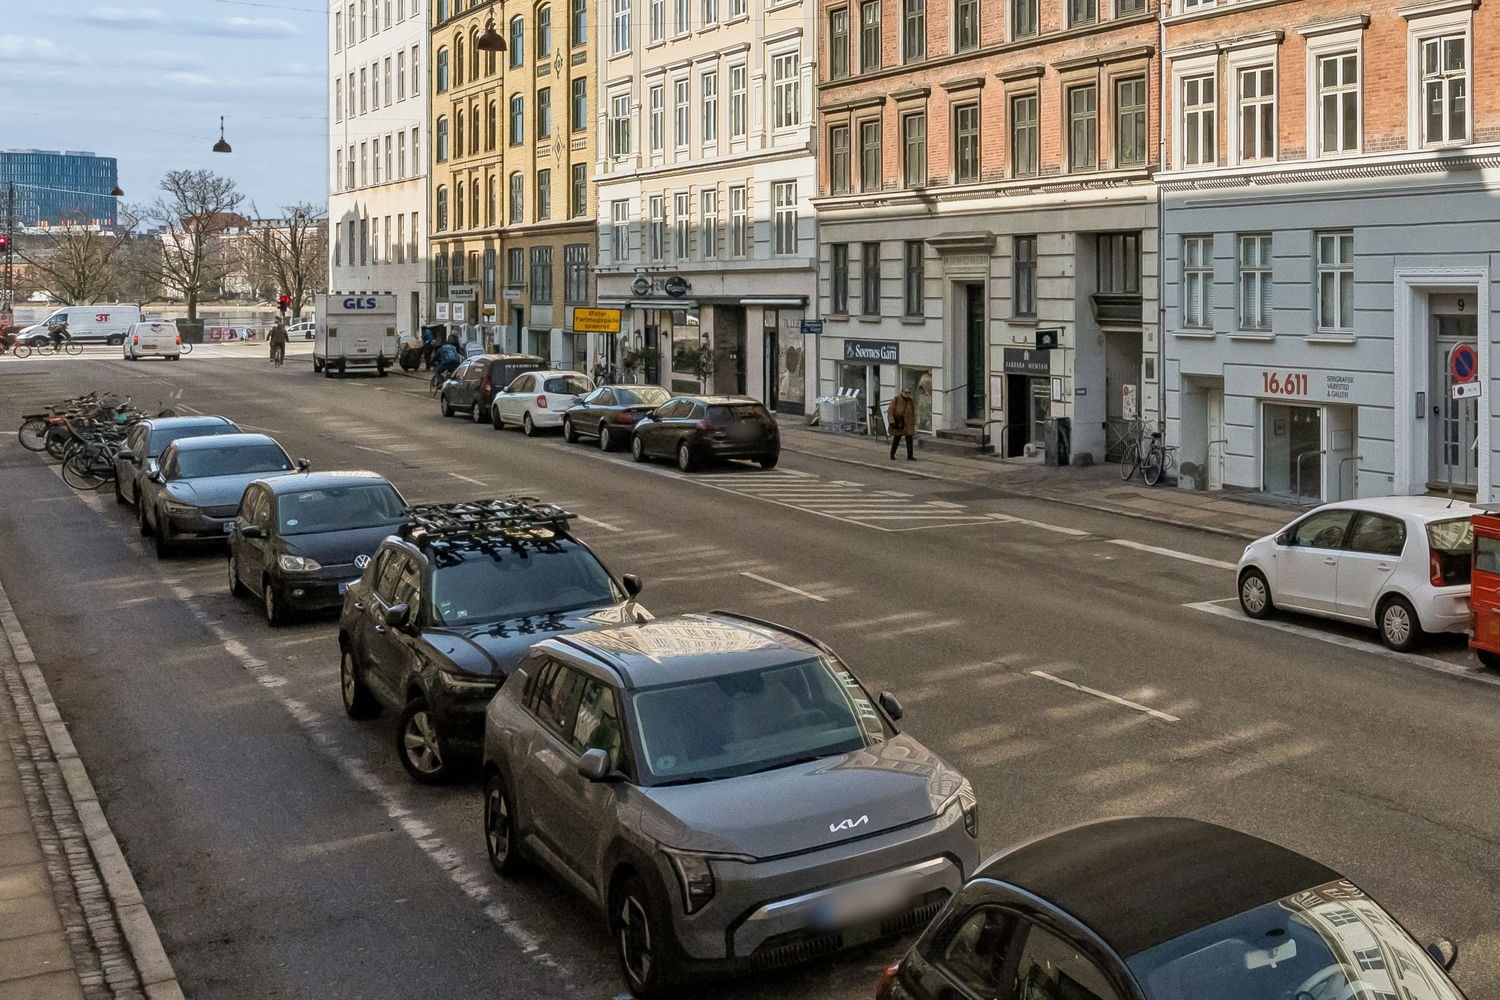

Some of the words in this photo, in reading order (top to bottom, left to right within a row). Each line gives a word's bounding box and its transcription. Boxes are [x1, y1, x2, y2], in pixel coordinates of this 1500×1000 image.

[343, 298, 376, 309] GLS
[1457, 298, 1465, 311] 9
[95, 313, 110, 322] 3T
[880, 345, 897, 360] Garn
[1262, 371, 1308, 395] 16.611
[829, 814, 869, 833] KIA
